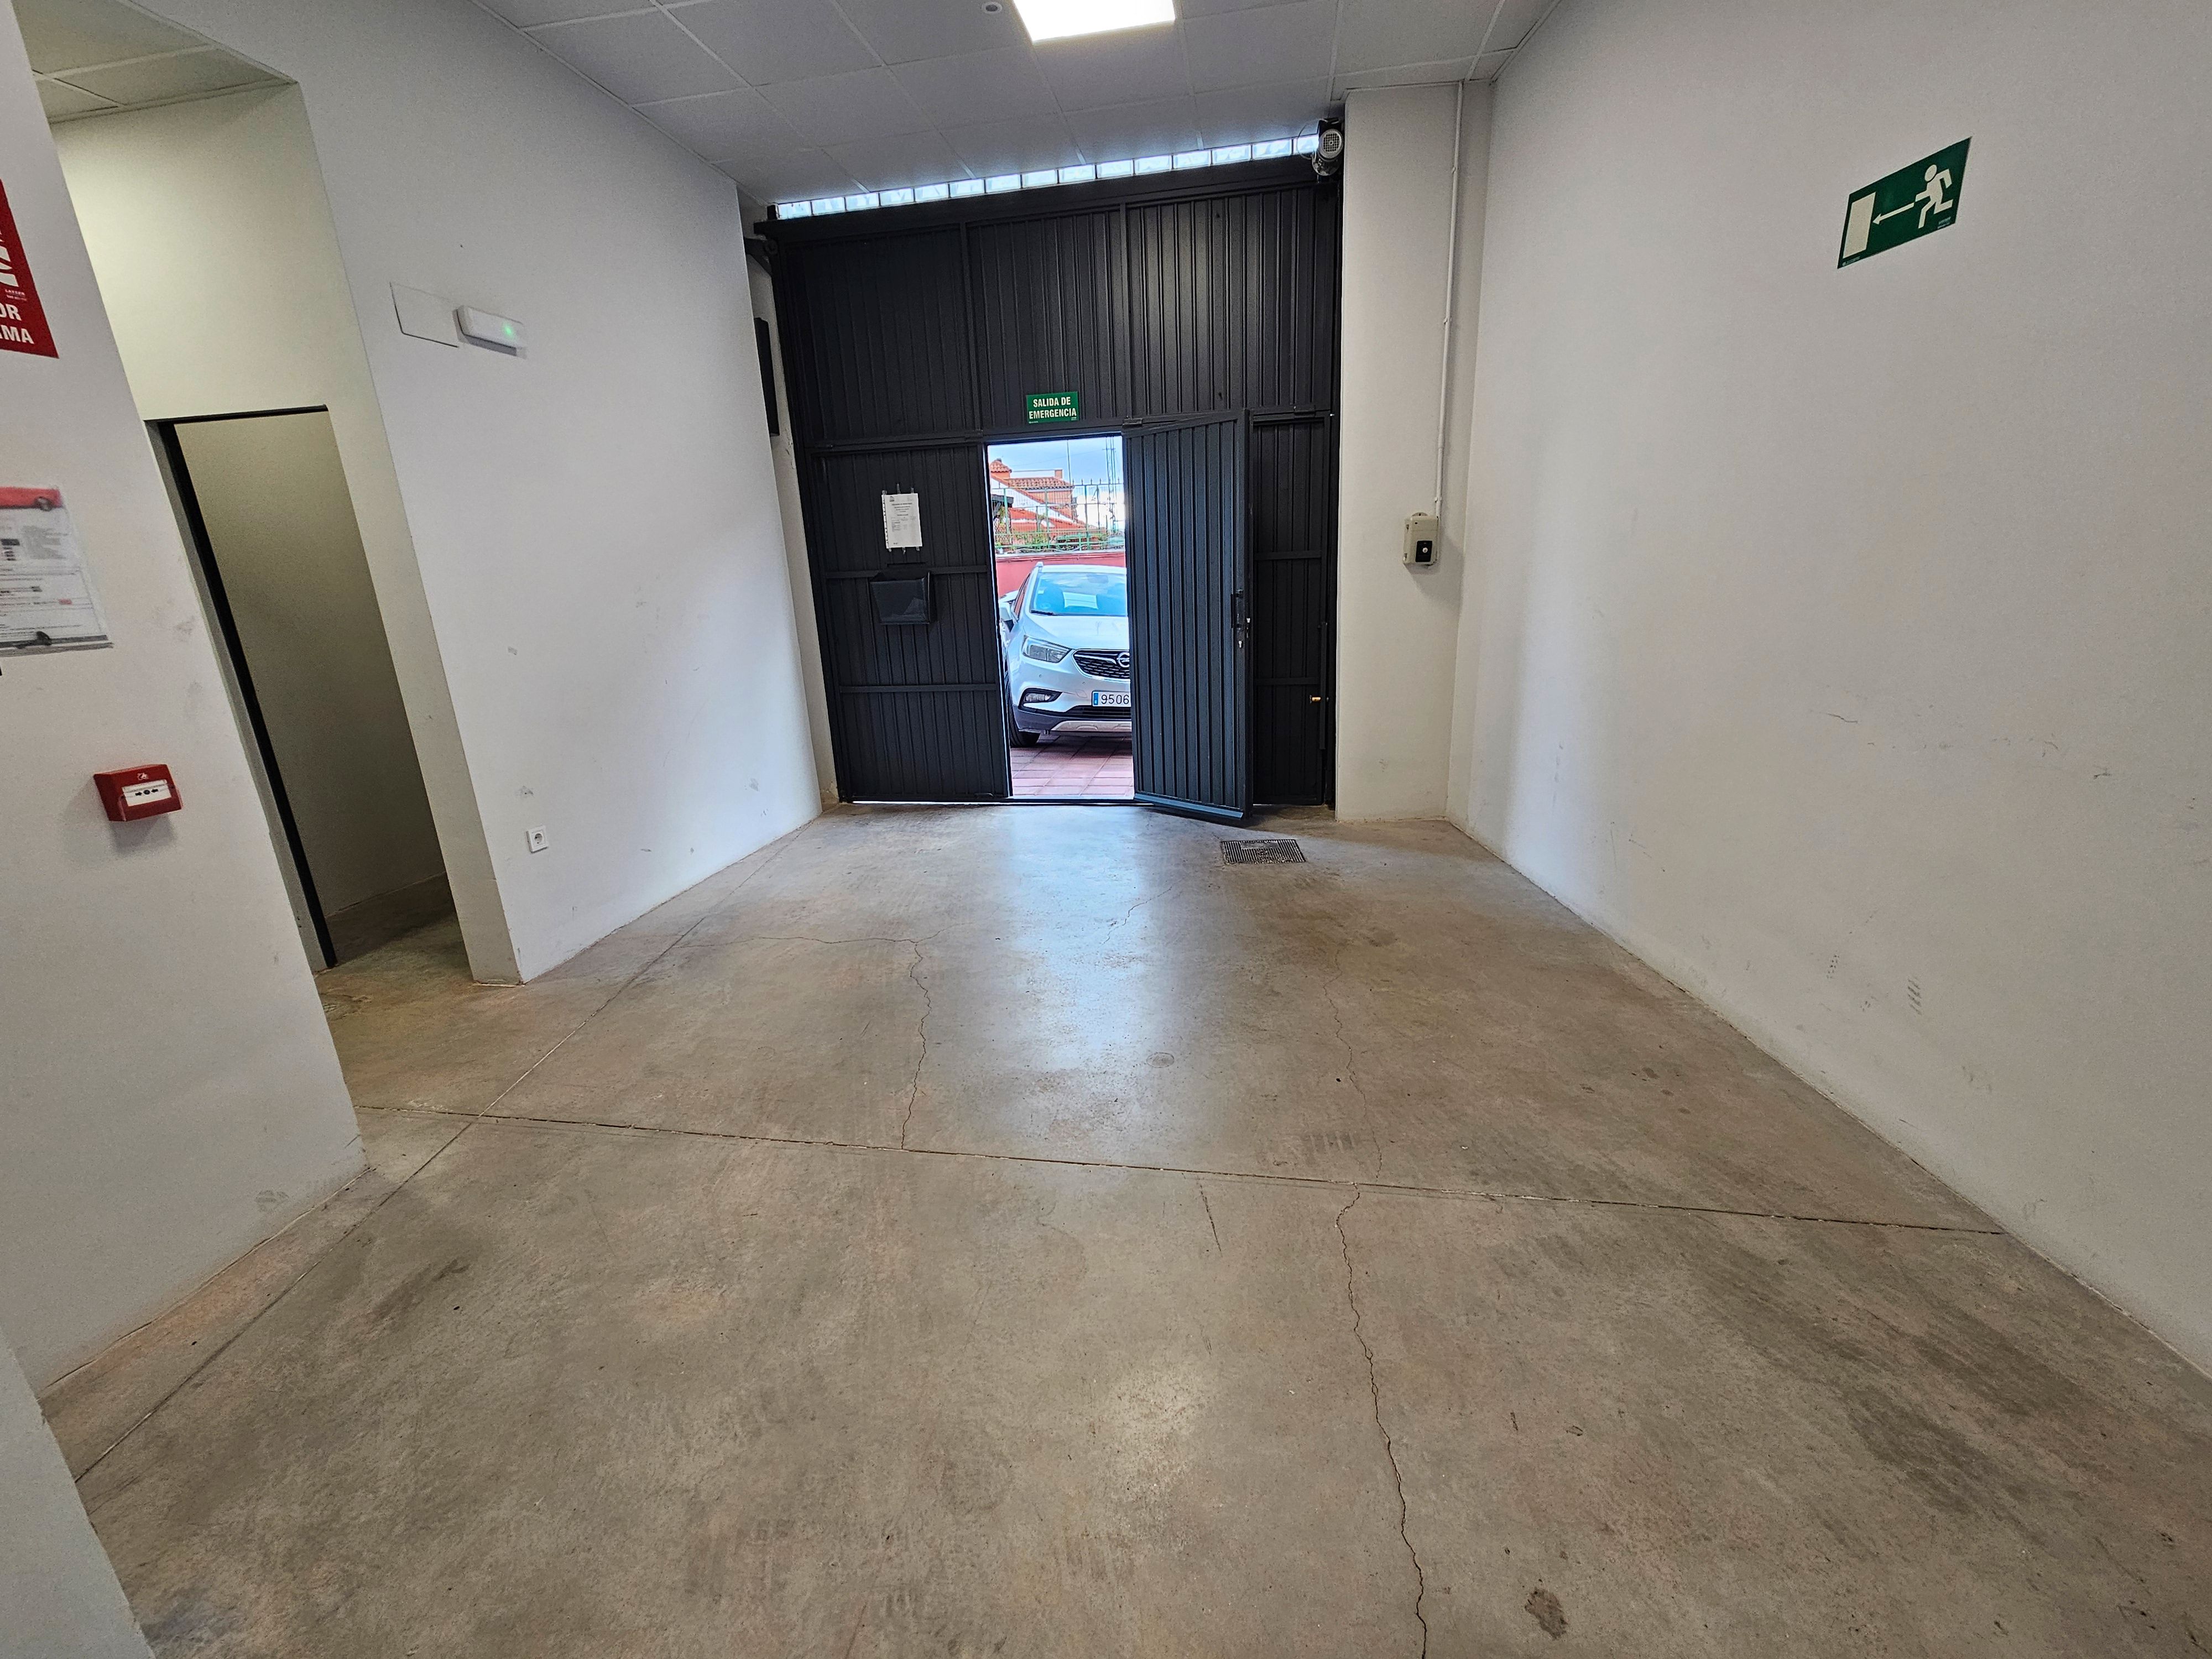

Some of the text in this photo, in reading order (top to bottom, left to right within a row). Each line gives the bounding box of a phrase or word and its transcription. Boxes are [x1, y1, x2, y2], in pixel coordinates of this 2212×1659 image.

[0, 325, 34, 345] MA
[1033, 397, 1071, 408] SALIDA DE
[1029, 408, 1077, 419] EMERGENCIA
[1101, 695, 1129, 704] 9506
